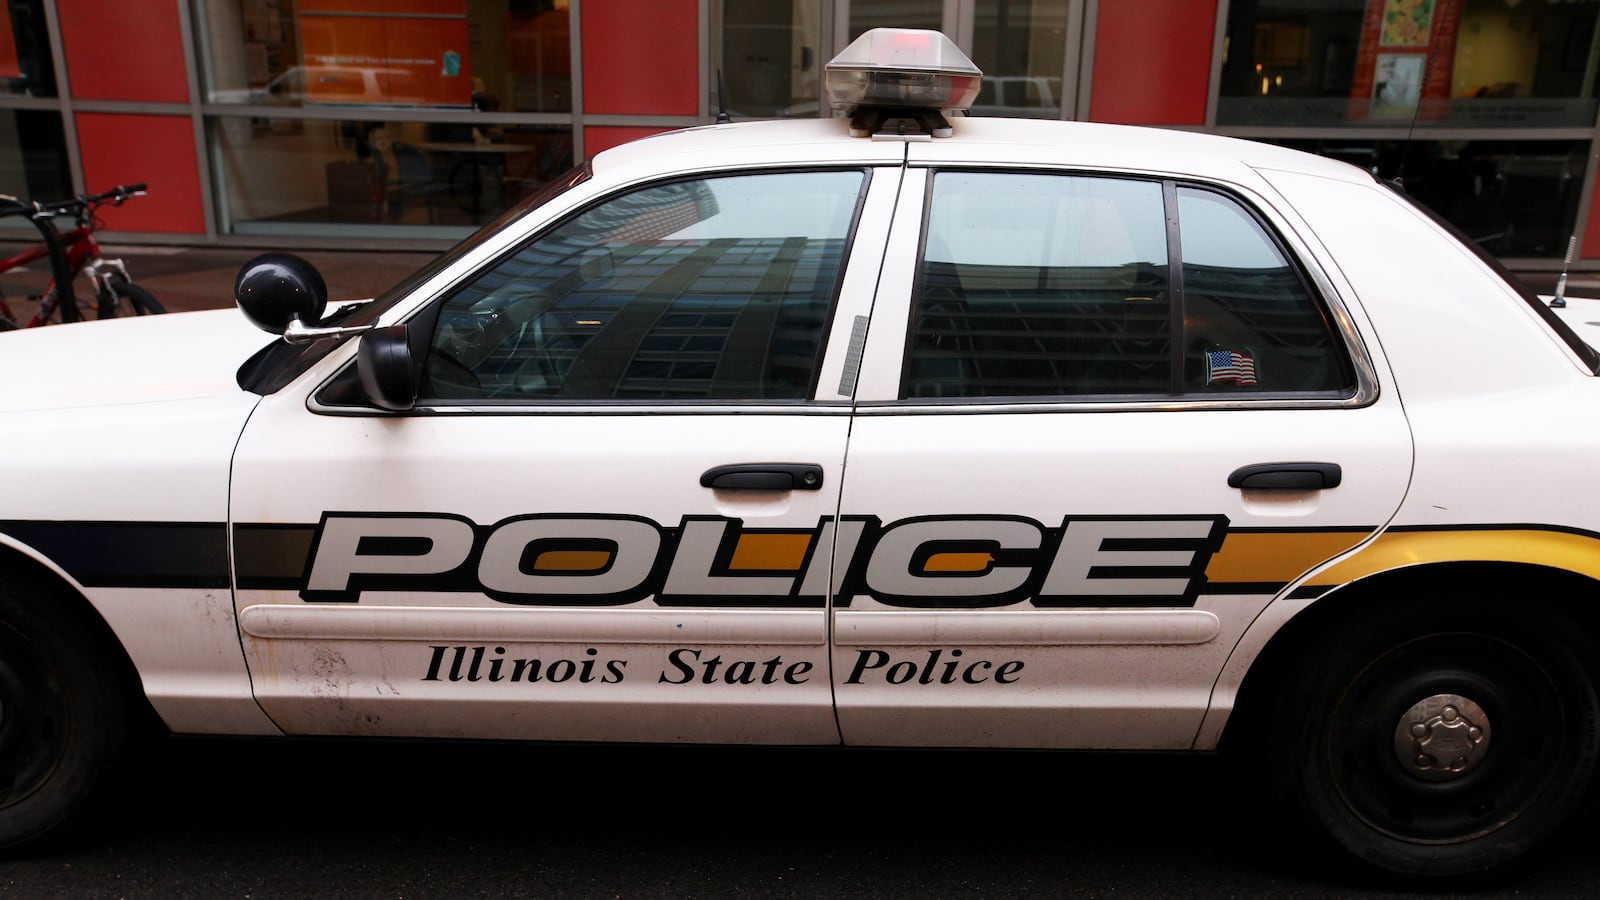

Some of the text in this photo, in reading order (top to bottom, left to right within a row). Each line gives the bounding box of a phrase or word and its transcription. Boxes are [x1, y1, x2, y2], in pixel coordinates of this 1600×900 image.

[302, 511, 1228, 606] POLICE
[421, 645, 1025, 685] Illinois State Police
